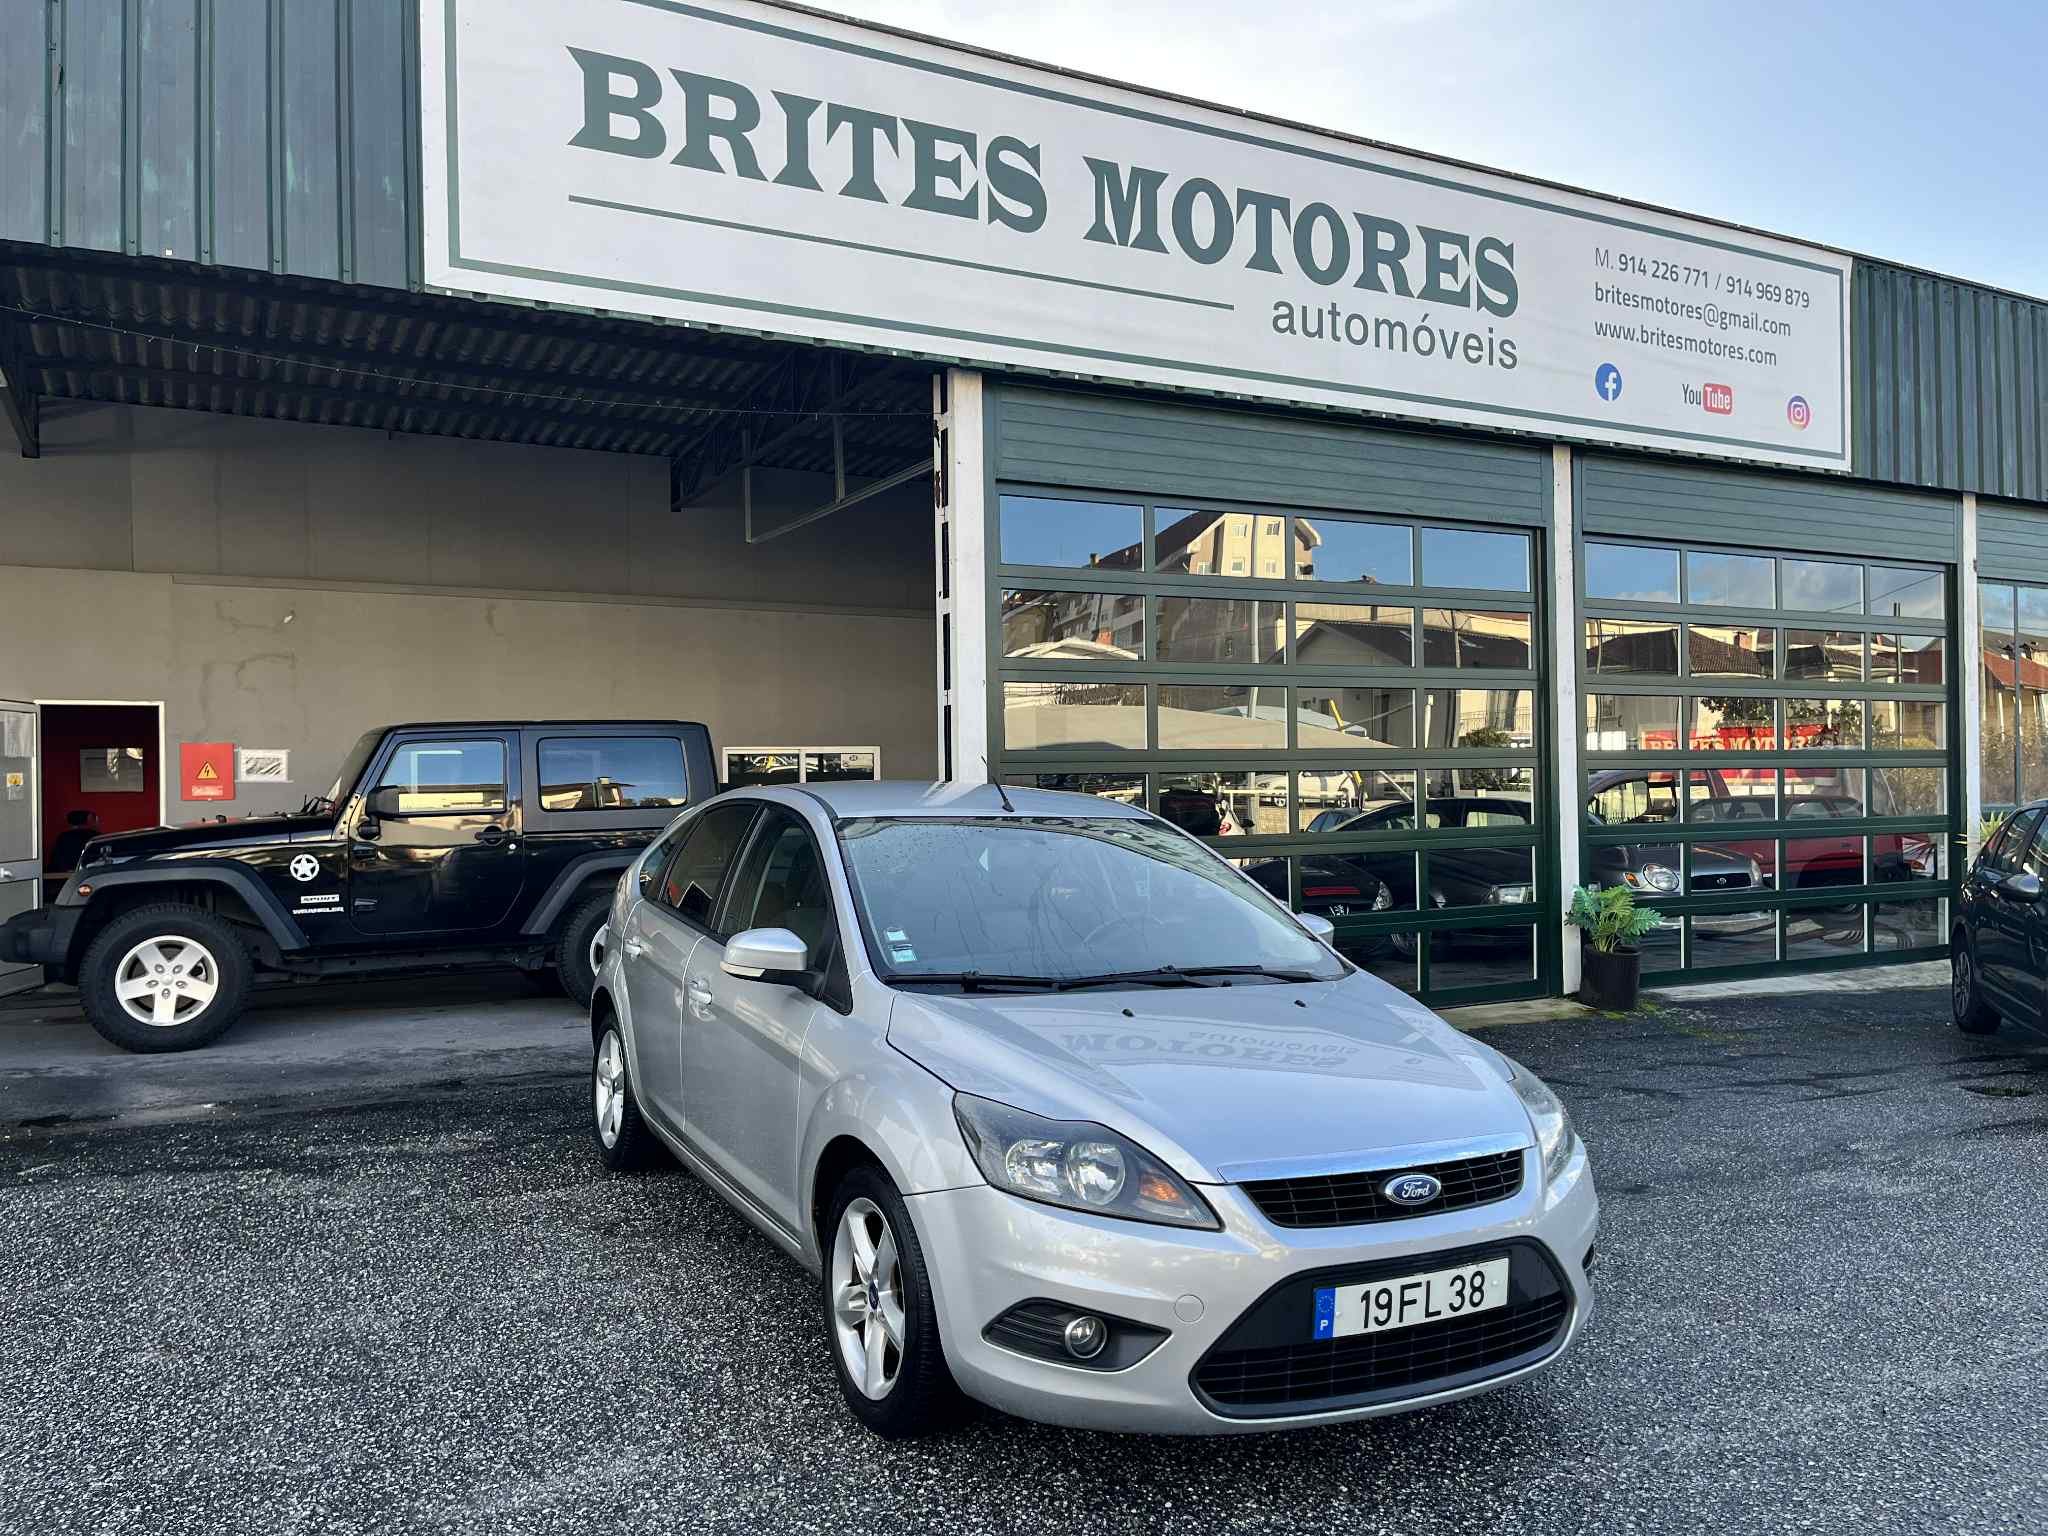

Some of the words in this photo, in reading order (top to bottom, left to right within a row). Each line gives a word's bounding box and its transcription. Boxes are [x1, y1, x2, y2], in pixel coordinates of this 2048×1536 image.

[566, 46, 1048, 234] BRITES
[1083, 156, 1519, 319] MOTORES
[1595, 247, 1614, 269] M.
[1618, 253, 1648, 277] 914
[1651, 260, 1679, 282] 226
[1683, 267, 1709, 289] 771
[1726, 276, 1753, 298] 914
[1756, 282, 1782, 303] 969
[1785, 288, 1810, 308] 879
[1272, 300, 1519, 370] automóveis
[1595, 281, 1792, 337] britesmotores@gmail.com
[1595, 321, 1777, 366] www.britesmotores.com
[1401, 1180, 1431, 1199] Ford
[1319, 1319, 1329, 1331] P
